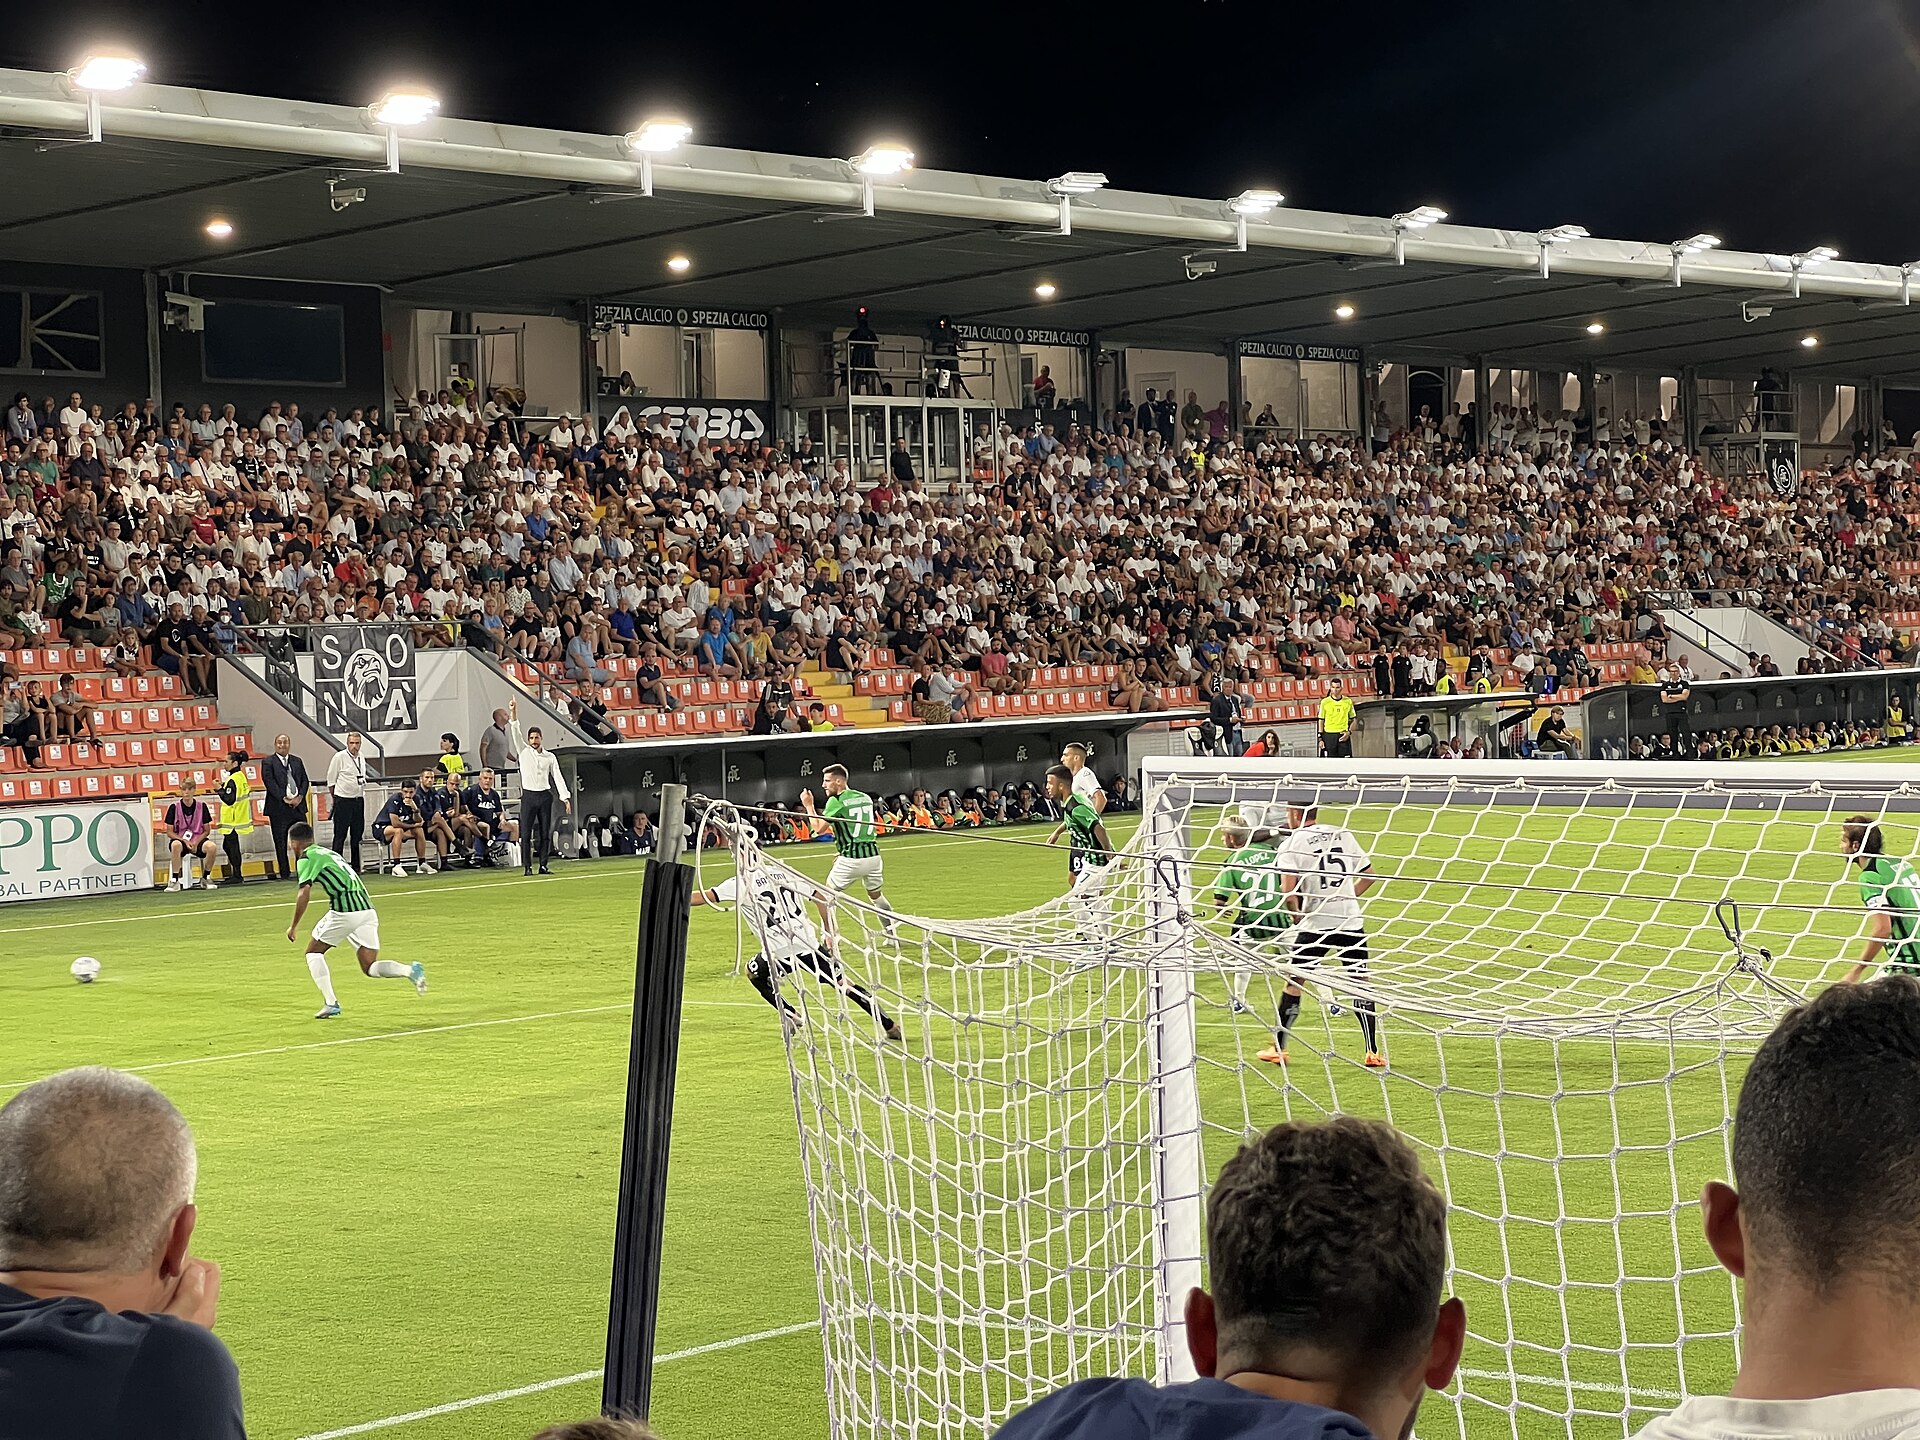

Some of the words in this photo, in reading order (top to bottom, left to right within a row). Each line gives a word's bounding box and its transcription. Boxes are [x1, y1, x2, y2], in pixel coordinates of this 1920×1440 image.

[595, 305, 632, 322] SPEZIA
[634, 307, 673, 323] CALCIO
[692, 310, 730, 325] SPEZIA
[731, 312, 768, 327] CALCIO
[951, 325, 979, 339] EZIA
[980, 326, 1012, 341] CALCIO
[1027, 329, 1059, 343] SPEZIA
[1059, 332, 1090, 345] CALCIO
[1240, 341, 1266, 355] SPEZIA
[1266, 343, 1292, 357] CALCIO
[1308, 347, 1335, 359] SPEZIA
[1335, 348, 1360, 360] CALCIO
[848, 805, 875, 838] 77
[0, 809, 140, 875] PPO
[39, 872, 137, 894] PARTNER
[1313, 846, 1347, 890] 15
[1240, 871, 1276, 908] 21
[757, 885, 802, 928] 20
